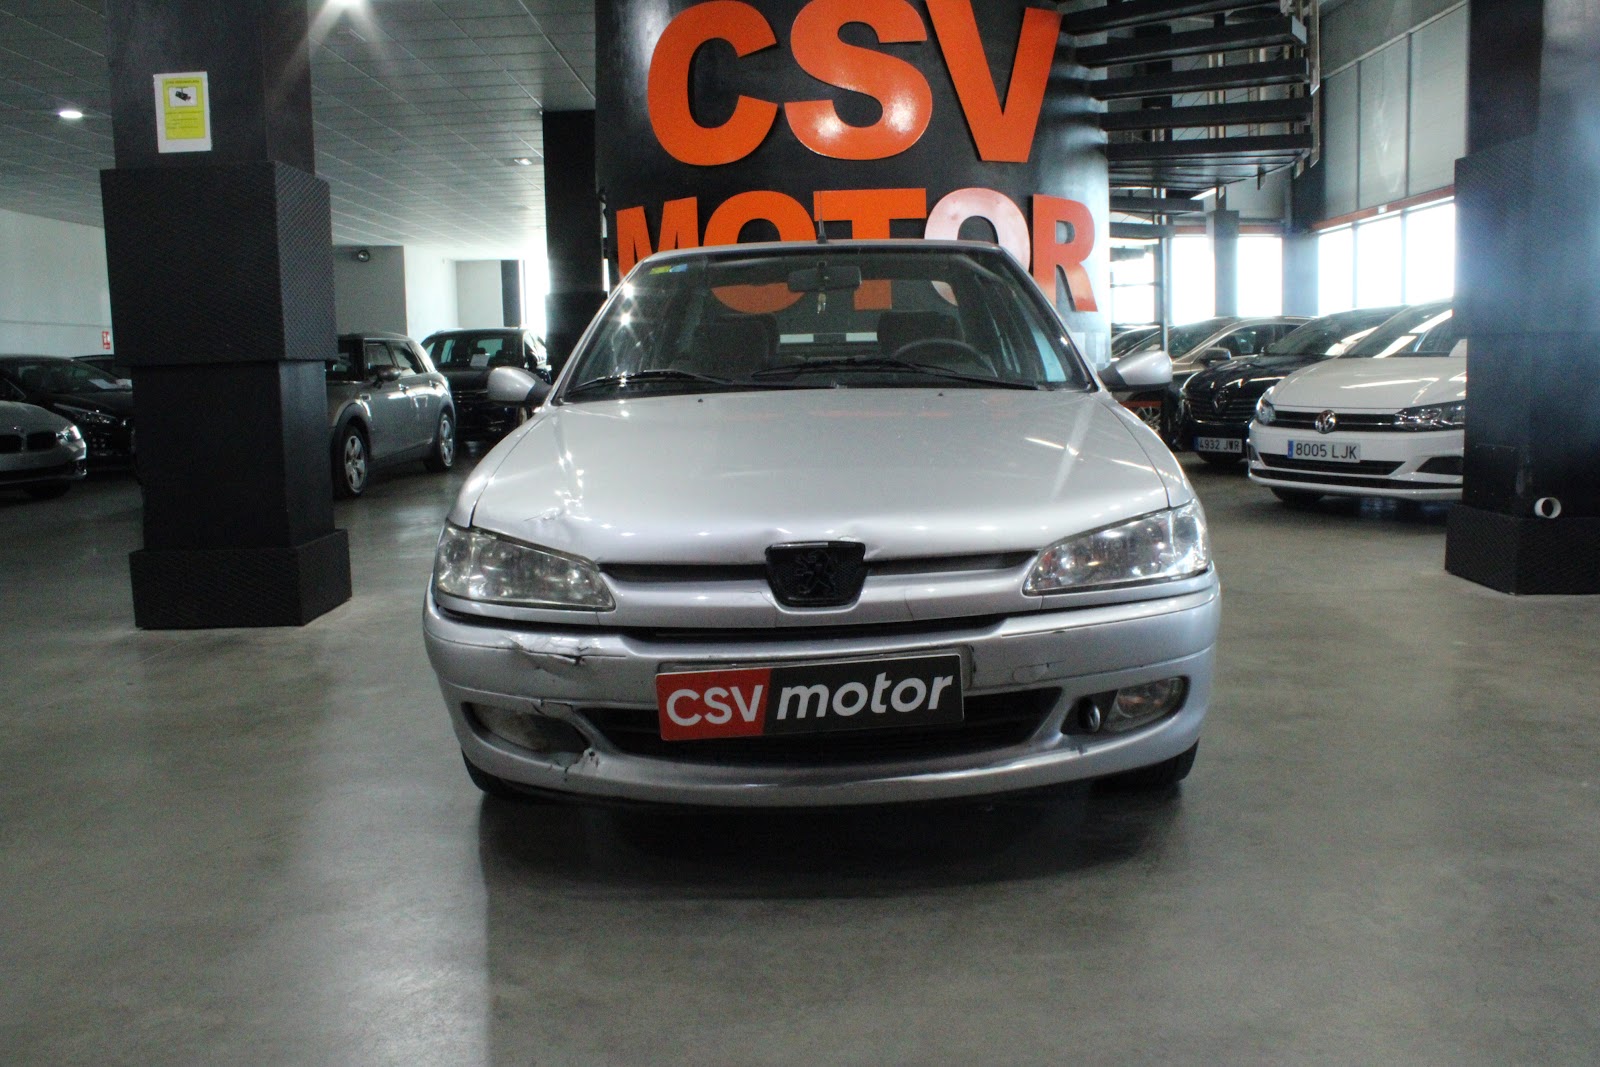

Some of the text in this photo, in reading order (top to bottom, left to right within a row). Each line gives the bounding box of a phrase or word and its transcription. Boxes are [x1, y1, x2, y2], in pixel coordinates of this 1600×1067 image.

[648, 0, 1062, 166] CSV
[616, 188, 1099, 312] MOTOR
[1200, 439, 1219, 450] 4932
[1295, 443, 1357, 460] 8005 LJK
[666, 672, 953, 726] CSV motor
